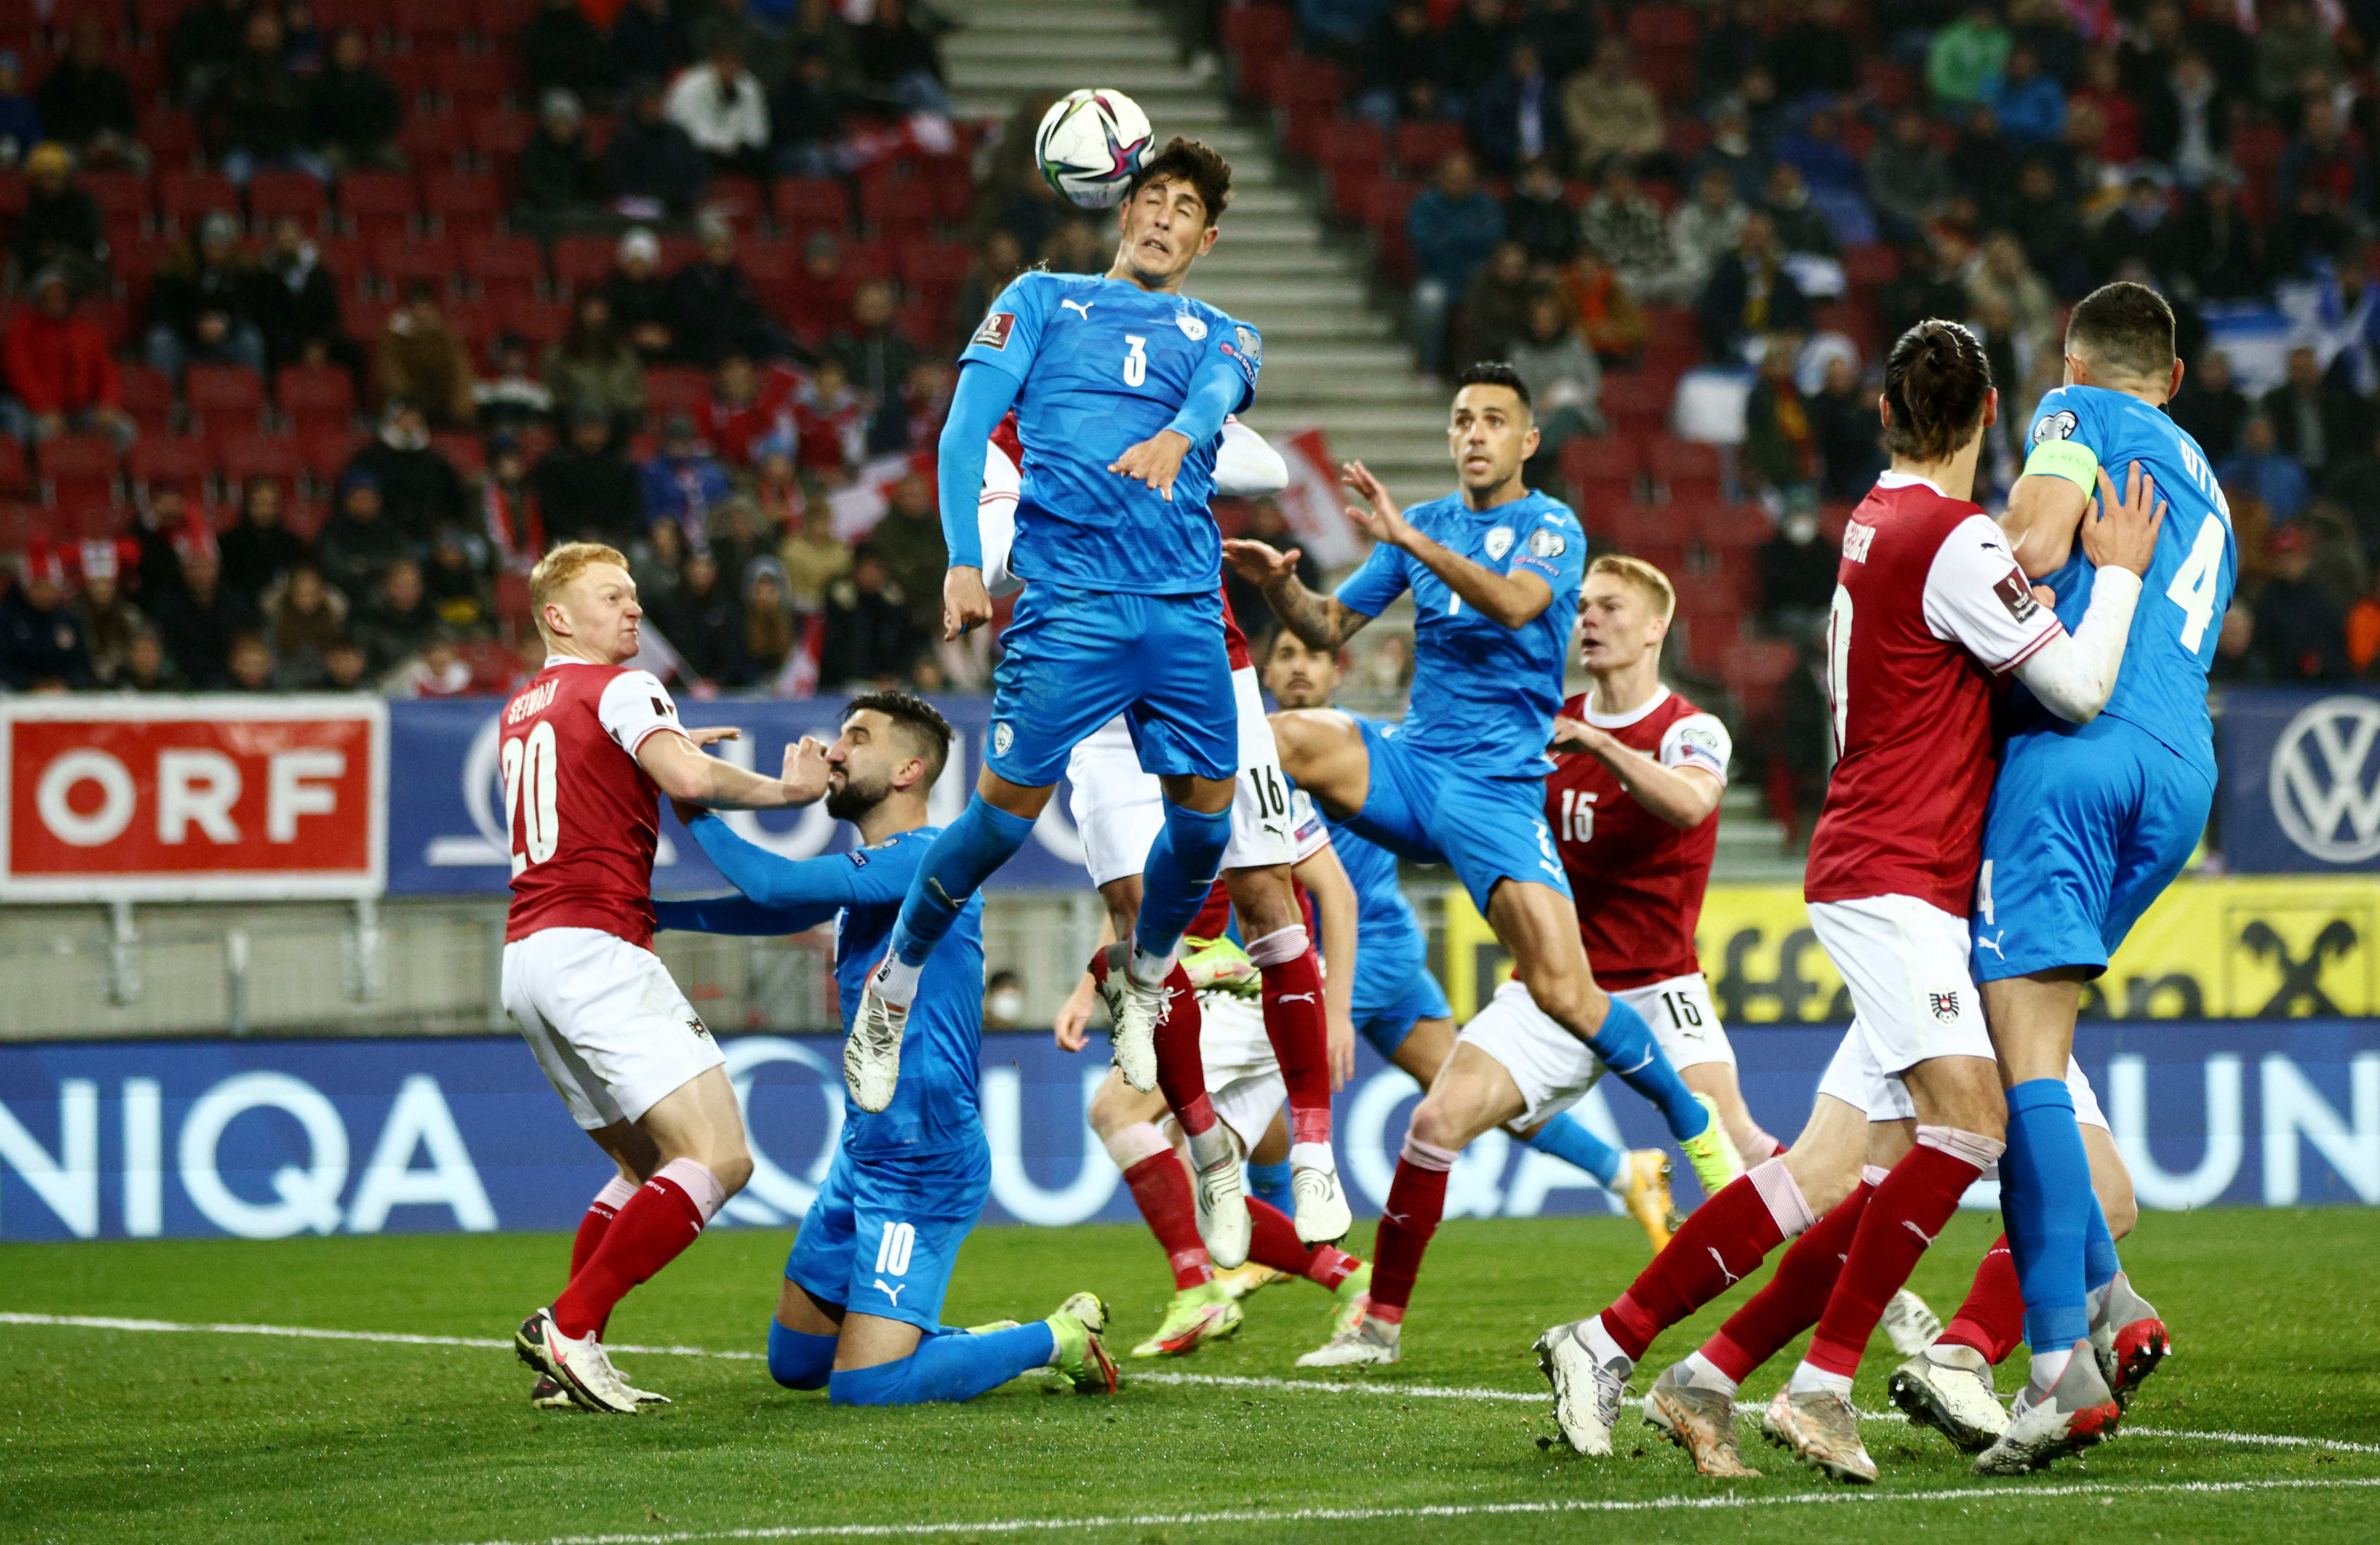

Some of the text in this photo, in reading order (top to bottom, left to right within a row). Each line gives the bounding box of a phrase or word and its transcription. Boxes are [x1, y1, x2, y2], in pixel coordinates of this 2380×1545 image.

[1123, 335, 1147, 387] 3
[2166, 512, 2226, 656] 4
[36, 747, 347, 847] ORF
[502, 720, 559, 880] 20
[1250, 765, 1284, 819] 16
[1562, 788, 1599, 843] 15
[1662, 991, 1702, 1029] 15
[875, 1221, 916, 1277] 10
